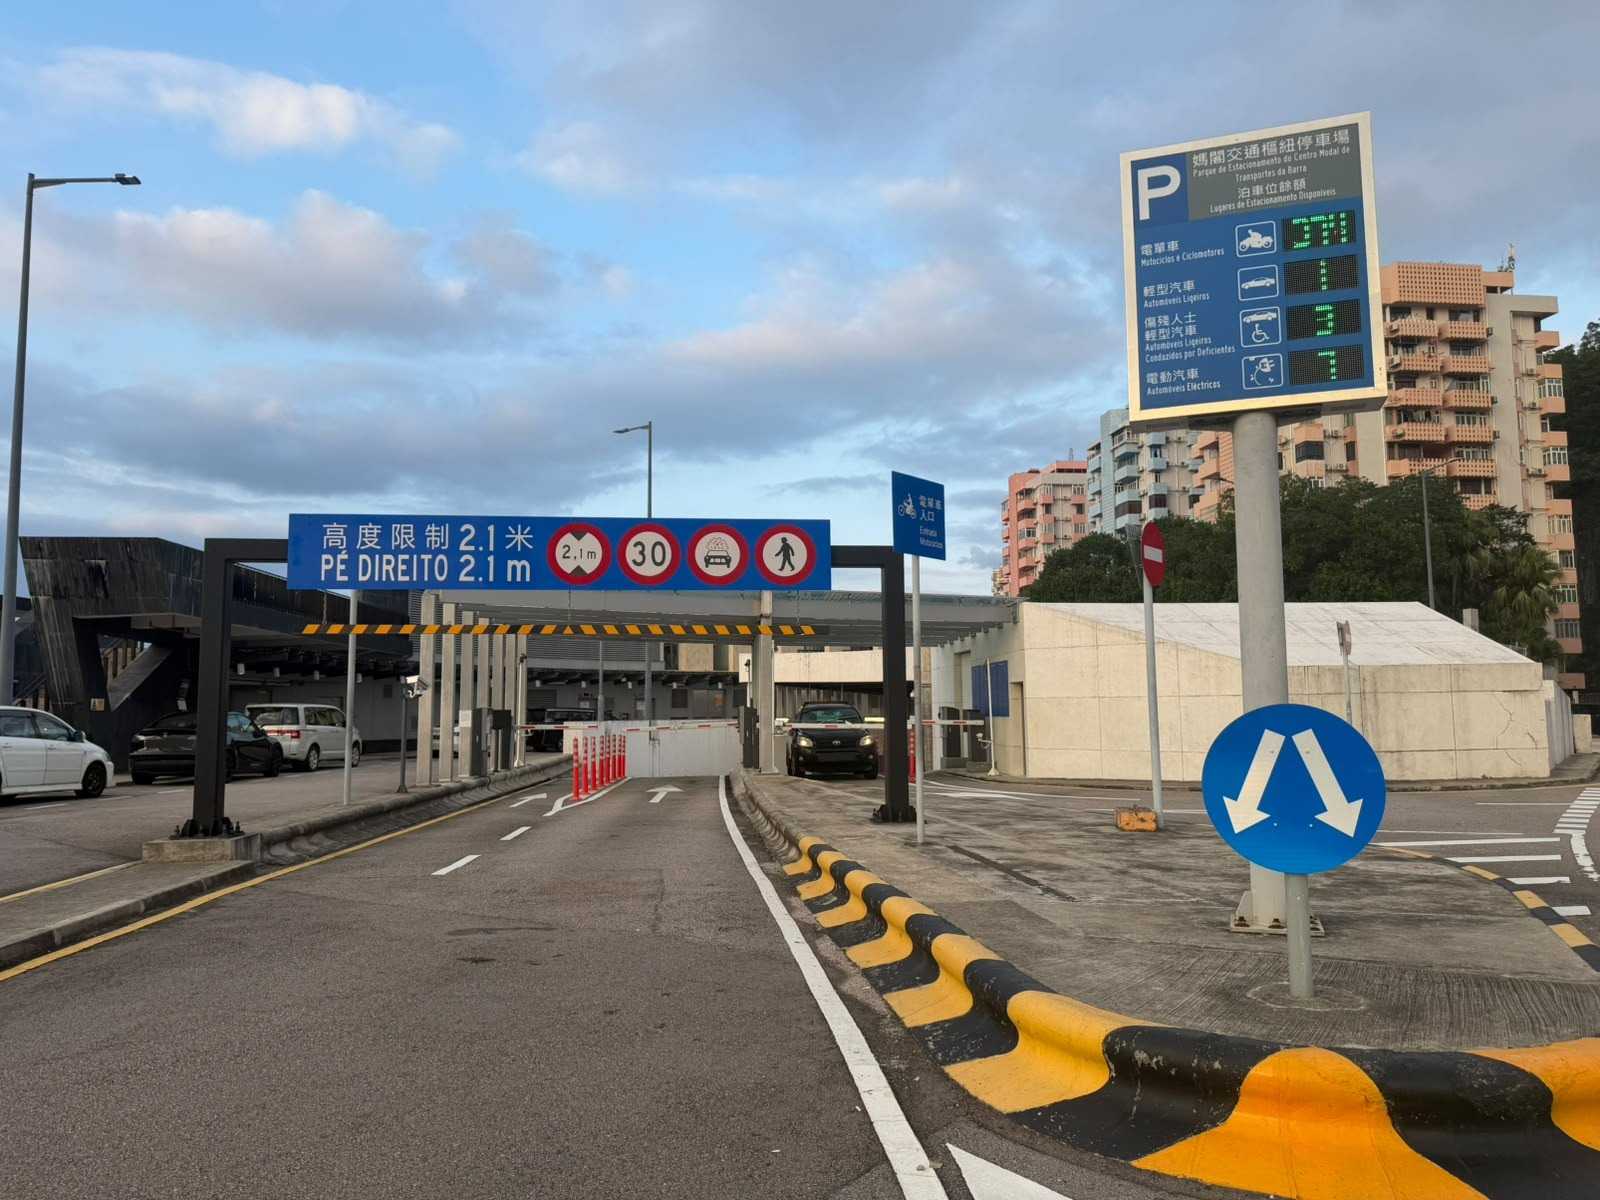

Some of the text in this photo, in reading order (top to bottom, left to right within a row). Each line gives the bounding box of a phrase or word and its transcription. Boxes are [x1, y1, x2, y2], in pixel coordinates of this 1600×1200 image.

[1193, 145, 1350, 177] Parque de Estacionamento do Centro Modal de
[1235, 164, 1308, 184] Transportes da Barra
[1137, 165, 1182, 221] P
[1209, 202, 1236, 214] Lugares
[1236, 199, 1245, 209] de
[1246, 193, 1297, 208] Estacionamento
[1315, 305, 1333, 336] 3
[1184, 350, 1196, 360] por
[1318, 351, 1337, 380] 7
[321, 522, 534, 552] 高度限制 2.1 米
[320, 550, 531, 583] PÉ DIREITO 2.1 m
[587, 550, 597, 560] m
[631, 540, 667, 567] 30
